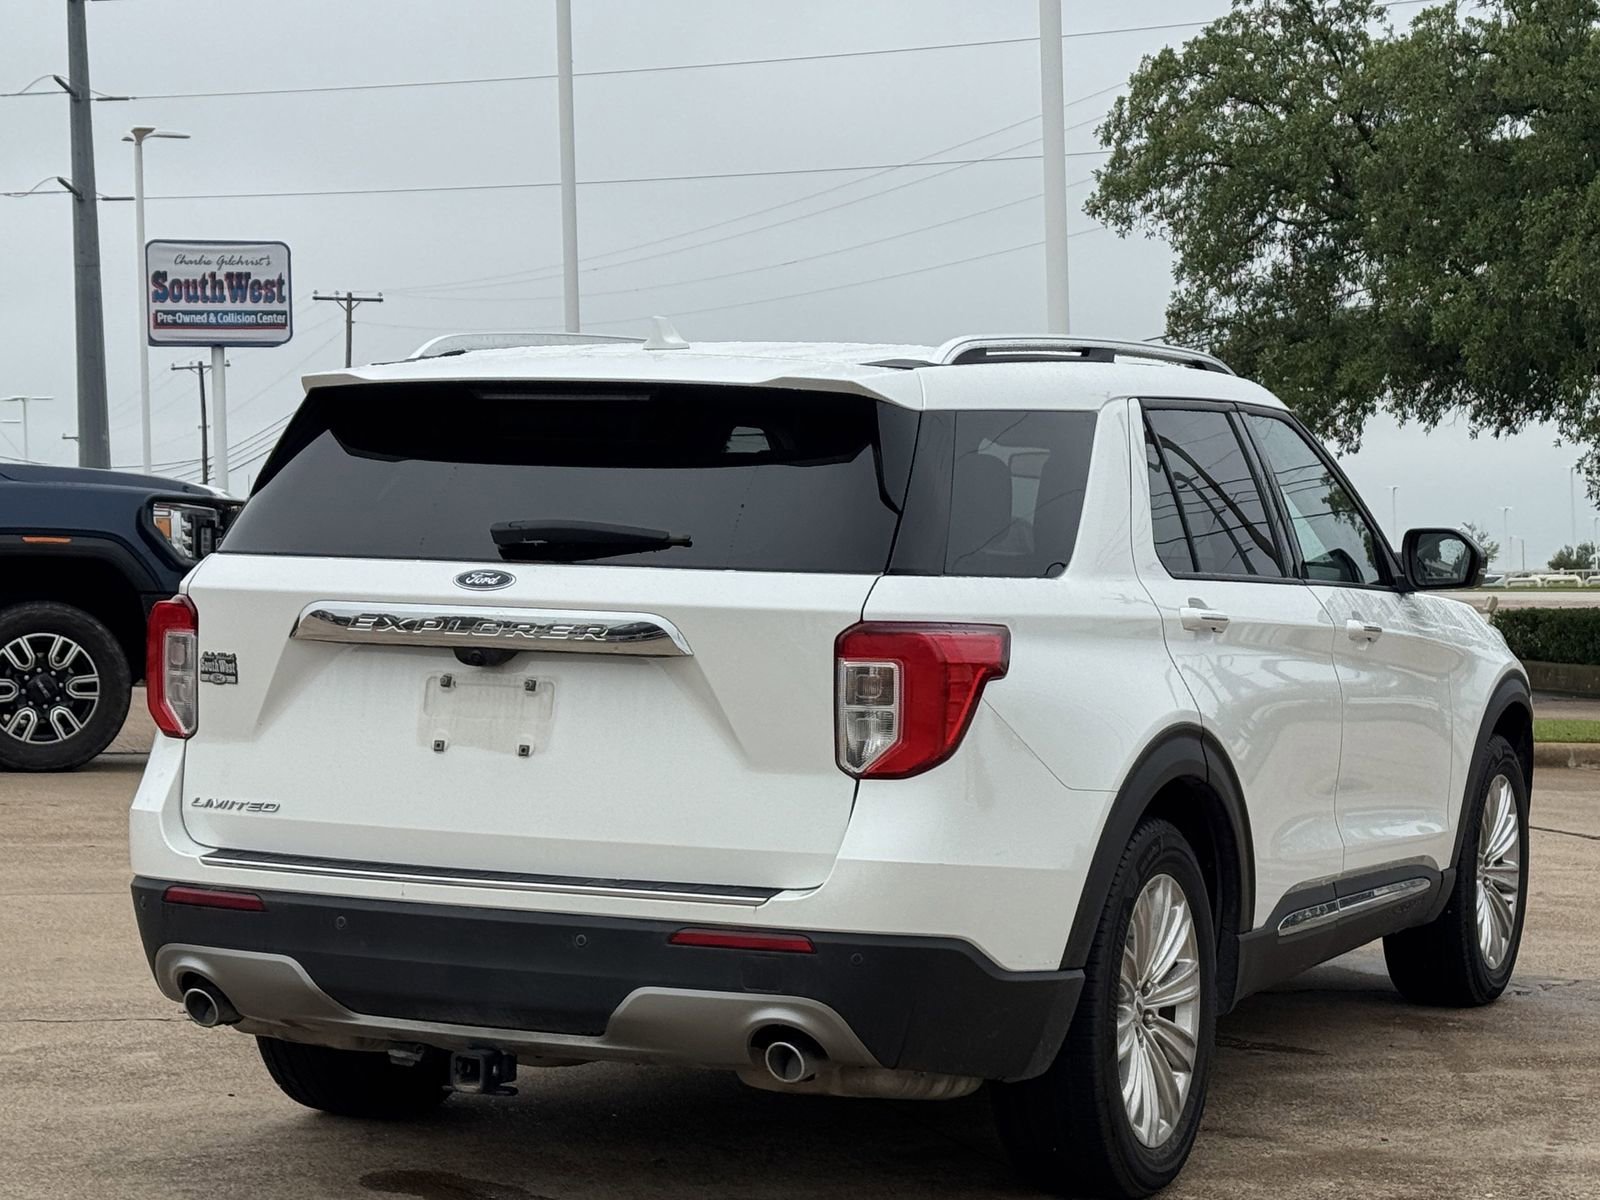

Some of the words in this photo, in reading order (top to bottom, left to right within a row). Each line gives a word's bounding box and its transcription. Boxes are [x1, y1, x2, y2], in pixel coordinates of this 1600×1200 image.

[174, 253, 213, 266] Charlie
[216, 254, 272, 271] Gilchrist's
[157, 312, 207, 324] Pre-Owned
[208, 313, 217, 324] &
[217, 312, 256, 324] Collision
[256, 312, 286, 324] Center
[465, 572, 500, 585] Ford
[347, 613, 611, 641] EXPLORER
[191, 797, 281, 813] LIMITED
